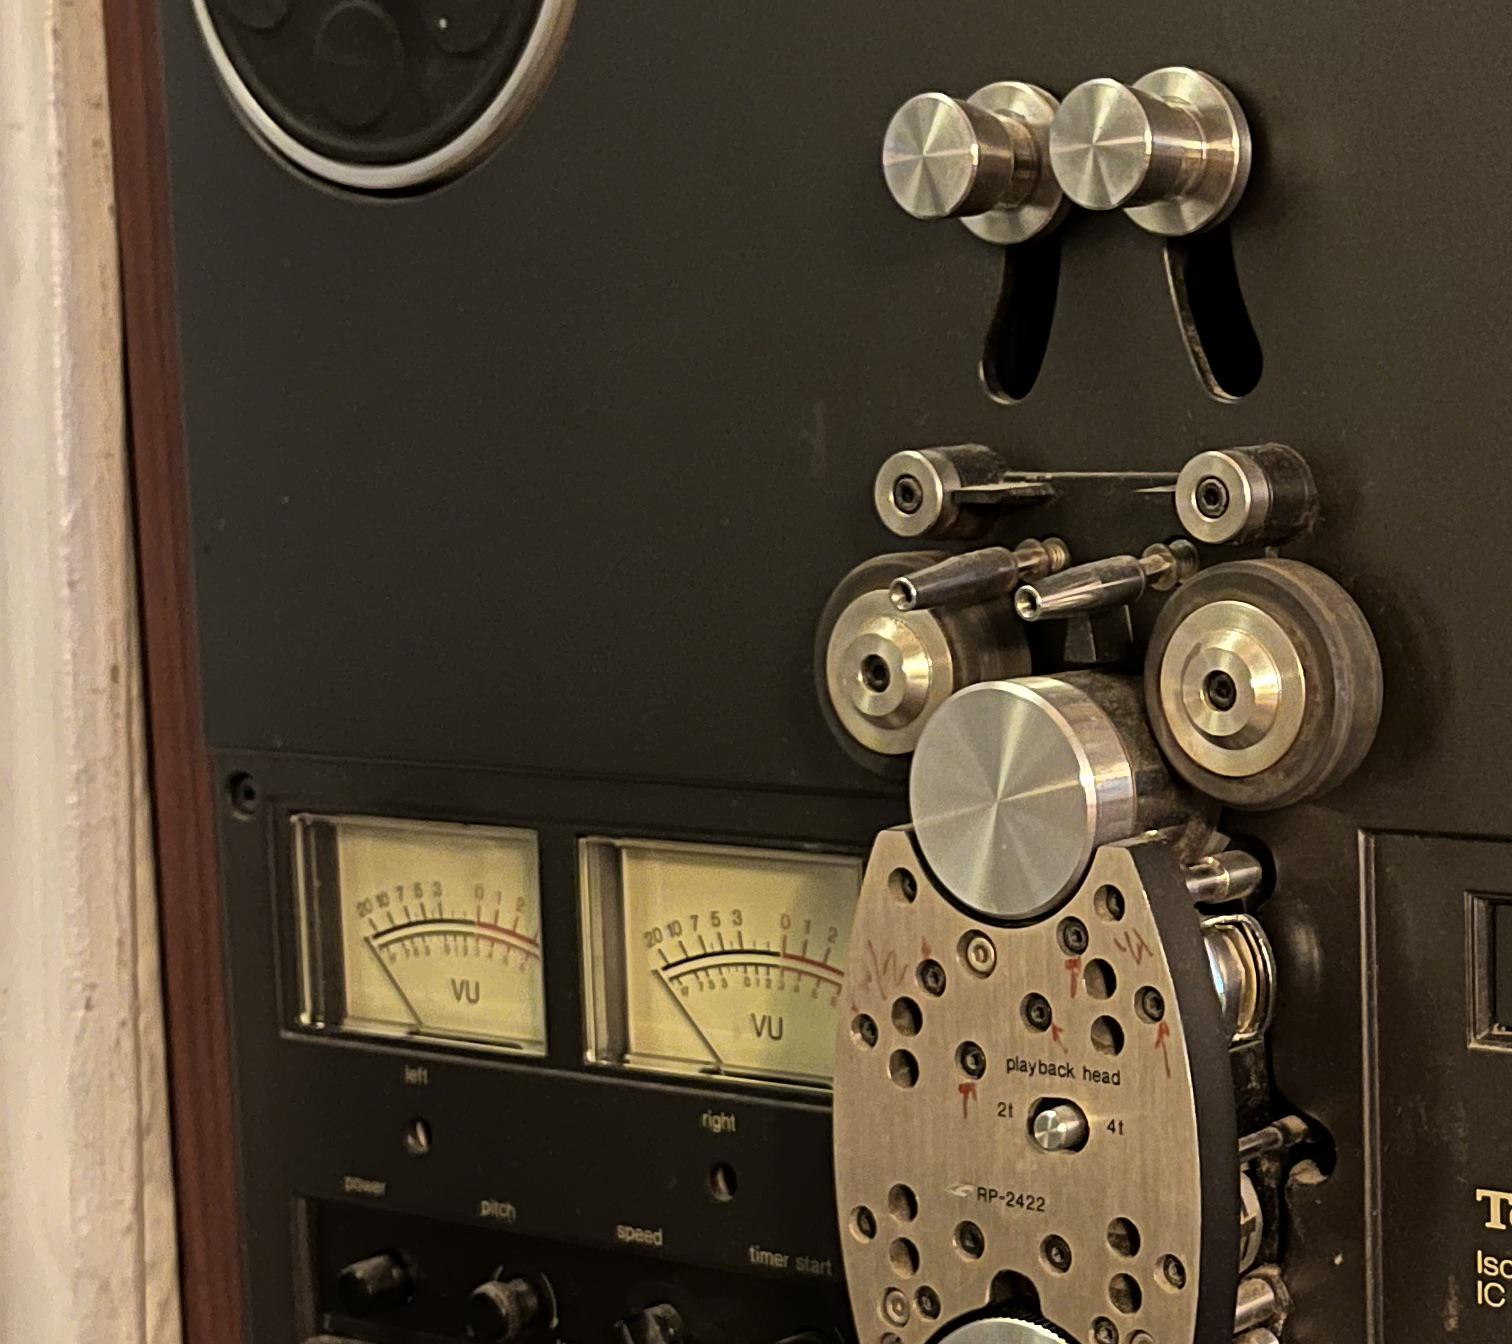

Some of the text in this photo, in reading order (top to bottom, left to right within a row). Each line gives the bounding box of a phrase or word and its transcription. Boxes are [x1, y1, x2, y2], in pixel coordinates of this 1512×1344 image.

[644, 927, 664, 949] 20
[667, 920, 683, 937] 10
[710, 910, 721, 928] 5
[732, 909, 743, 926] 3
[780, 913, 791, 930] 0
[827, 926, 839, 943] 2
[451, 978, 480, 1005] VU
[750, 1013, 784, 1042] VU
[404, 1066, 429, 1087] left
[1006, 1055, 1121, 1086] playback head
[702, 1111, 736, 1133] right
[996, 1102, 1014, 1120] 2t
[1106, 1118, 1125, 1136] 4t
[480, 1199, 517, 1224] pitch
[977, 1186, 1046, 1212] RP-2422
[616, 1223, 664, 1248] speed
[748, 1244, 833, 1277] timer start
[1476, 1280, 1507, 1309] IC
